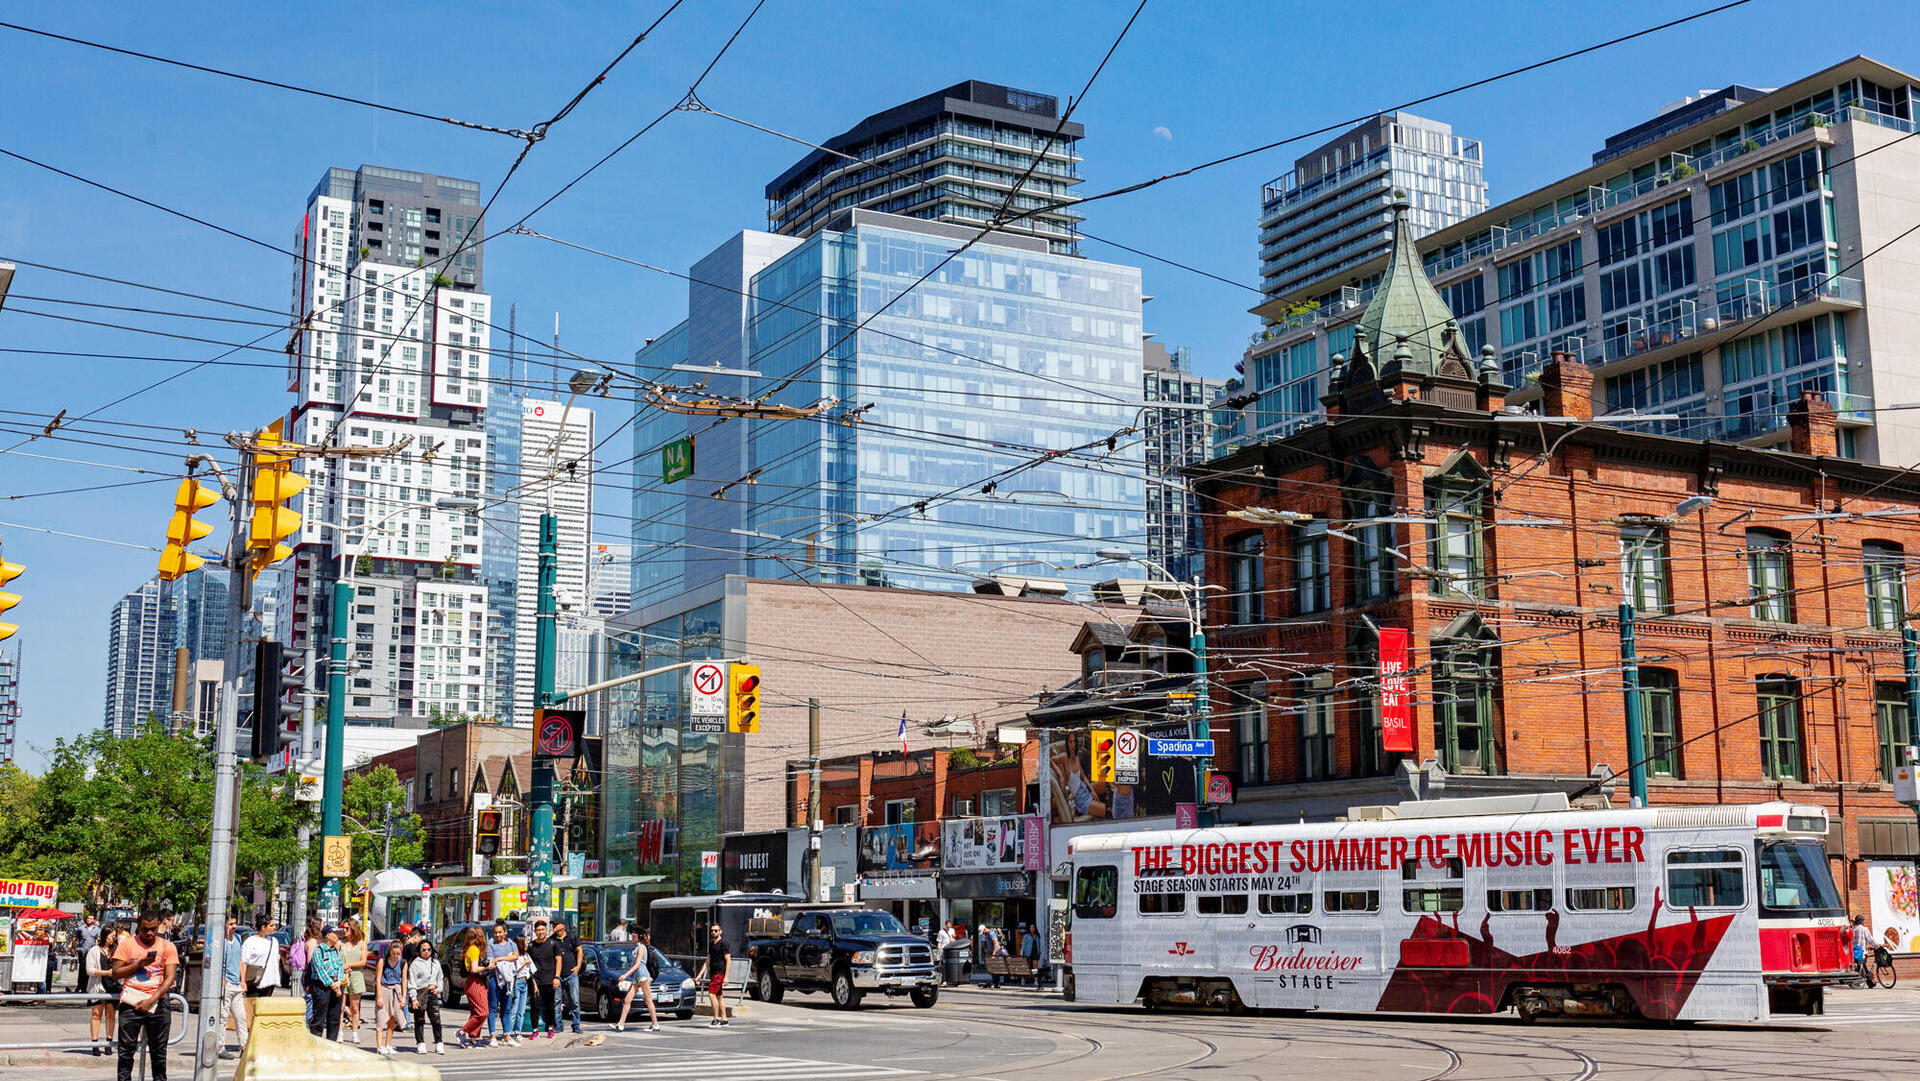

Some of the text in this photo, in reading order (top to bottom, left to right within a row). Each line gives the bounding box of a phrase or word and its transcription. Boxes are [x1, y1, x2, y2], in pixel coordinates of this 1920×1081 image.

[1382, 661, 1402, 674] LIVE
[1382, 677, 1406, 690] LOVE
[1383, 717, 1407, 728] BASIL
[1157, 741, 1193, 753] Spadina
[1180, 807, 1192, 829] AR
[1028, 820, 1040, 869] ARDENE
[1131, 826, 1645, 876] THE BIGGEST SUMMER OF MUSIC EVER
[0, 881, 54, 899] Hot Dog
[1133, 879, 1163, 893] STAGE
[1166, 878, 1206, 892] SEASON
[1209, 877, 1248, 891] STARTS
[1251, 877, 1275, 890] MAY
[8, 896, 39, 907] Poutine
[1249, 945, 1363, 971] Budweiser
[1552, 946, 1572, 955] 4082
[1279, 974, 1334, 989] STAGE
